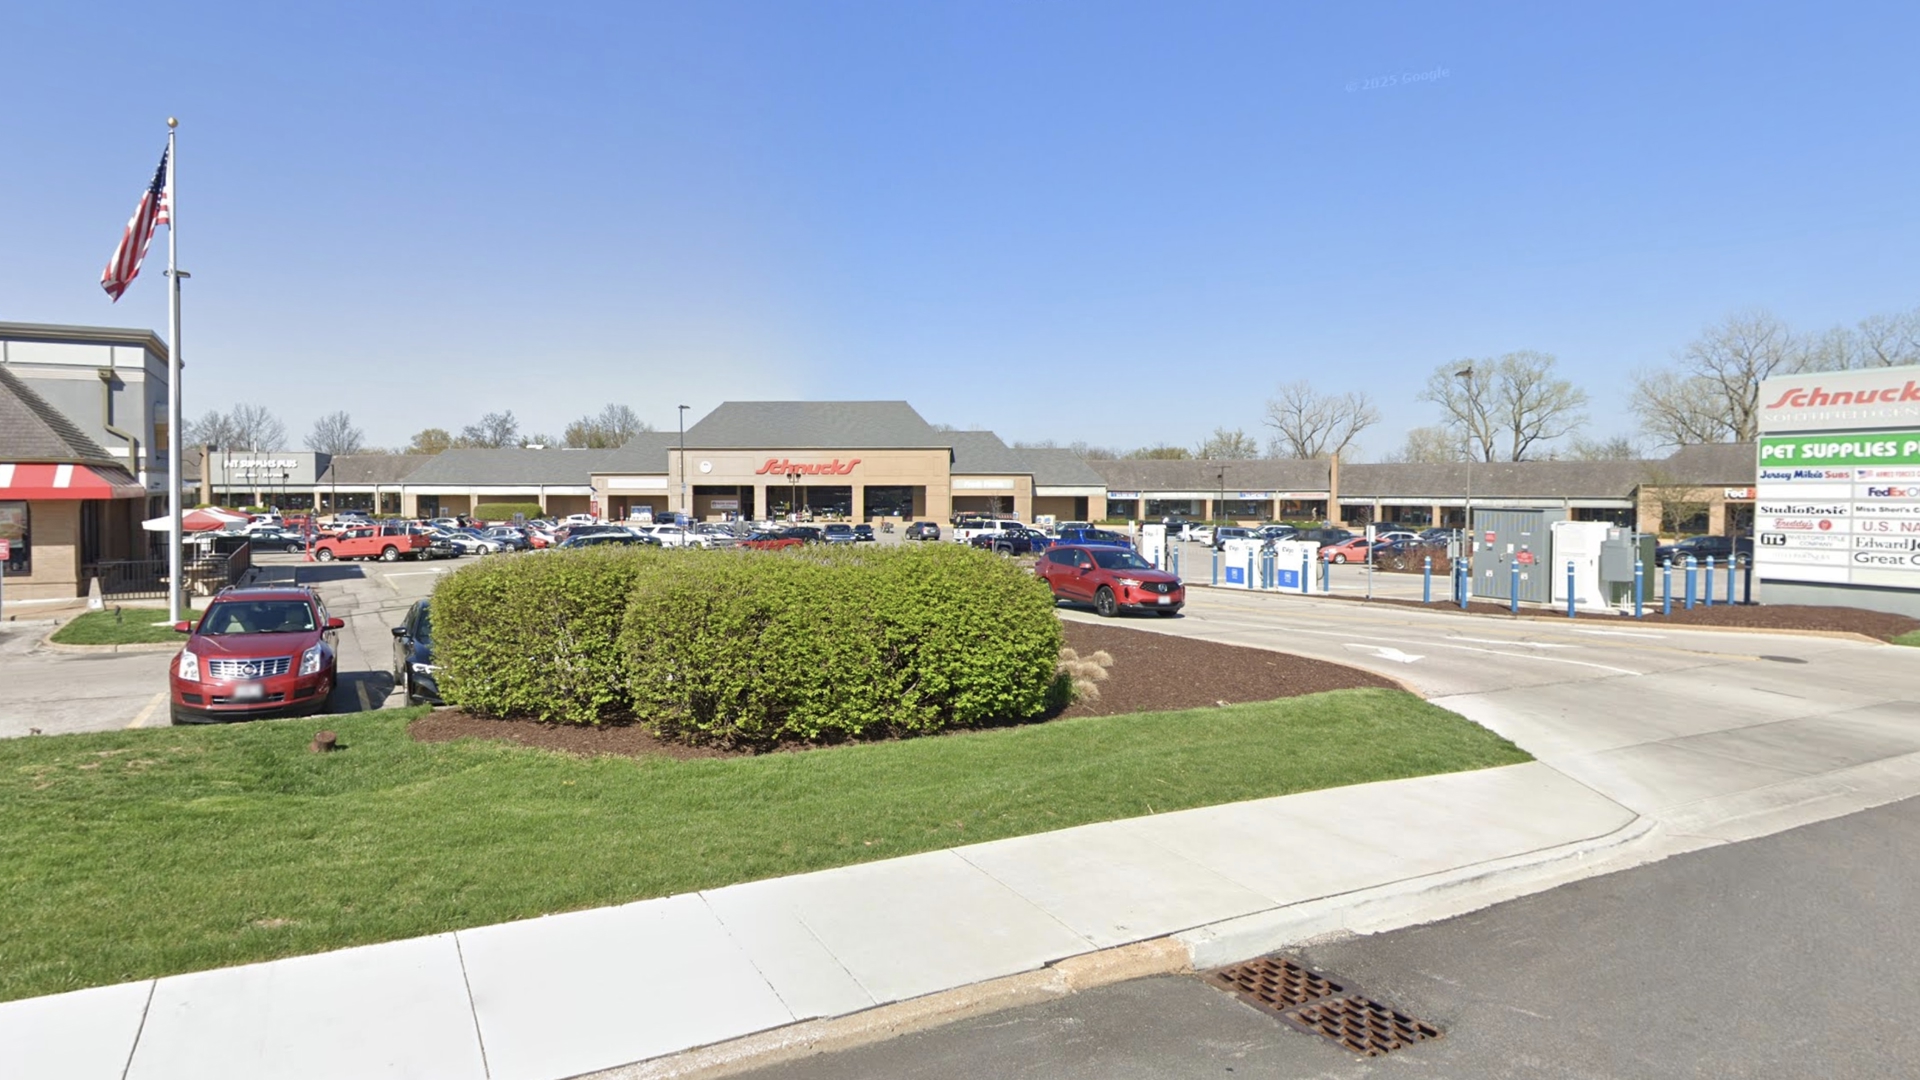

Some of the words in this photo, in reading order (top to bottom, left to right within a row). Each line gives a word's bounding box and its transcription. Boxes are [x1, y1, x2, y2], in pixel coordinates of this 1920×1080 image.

[1761, 444, 1796, 459] PET
[1801, 441, 1897, 458] SUPPLIES
[756, 459, 861, 475] Schnucks
[1760, 470, 1791, 481] Jersey
[1793, 470, 1823, 479] Mike's
[1868, 487, 1906, 497] FedEx
[1773, 518, 1814, 529] Freddy's
[1862, 521, 1893, 532] U.S.
[1856, 537, 1908, 549] Edward
[1854, 551, 1906, 564] Great
